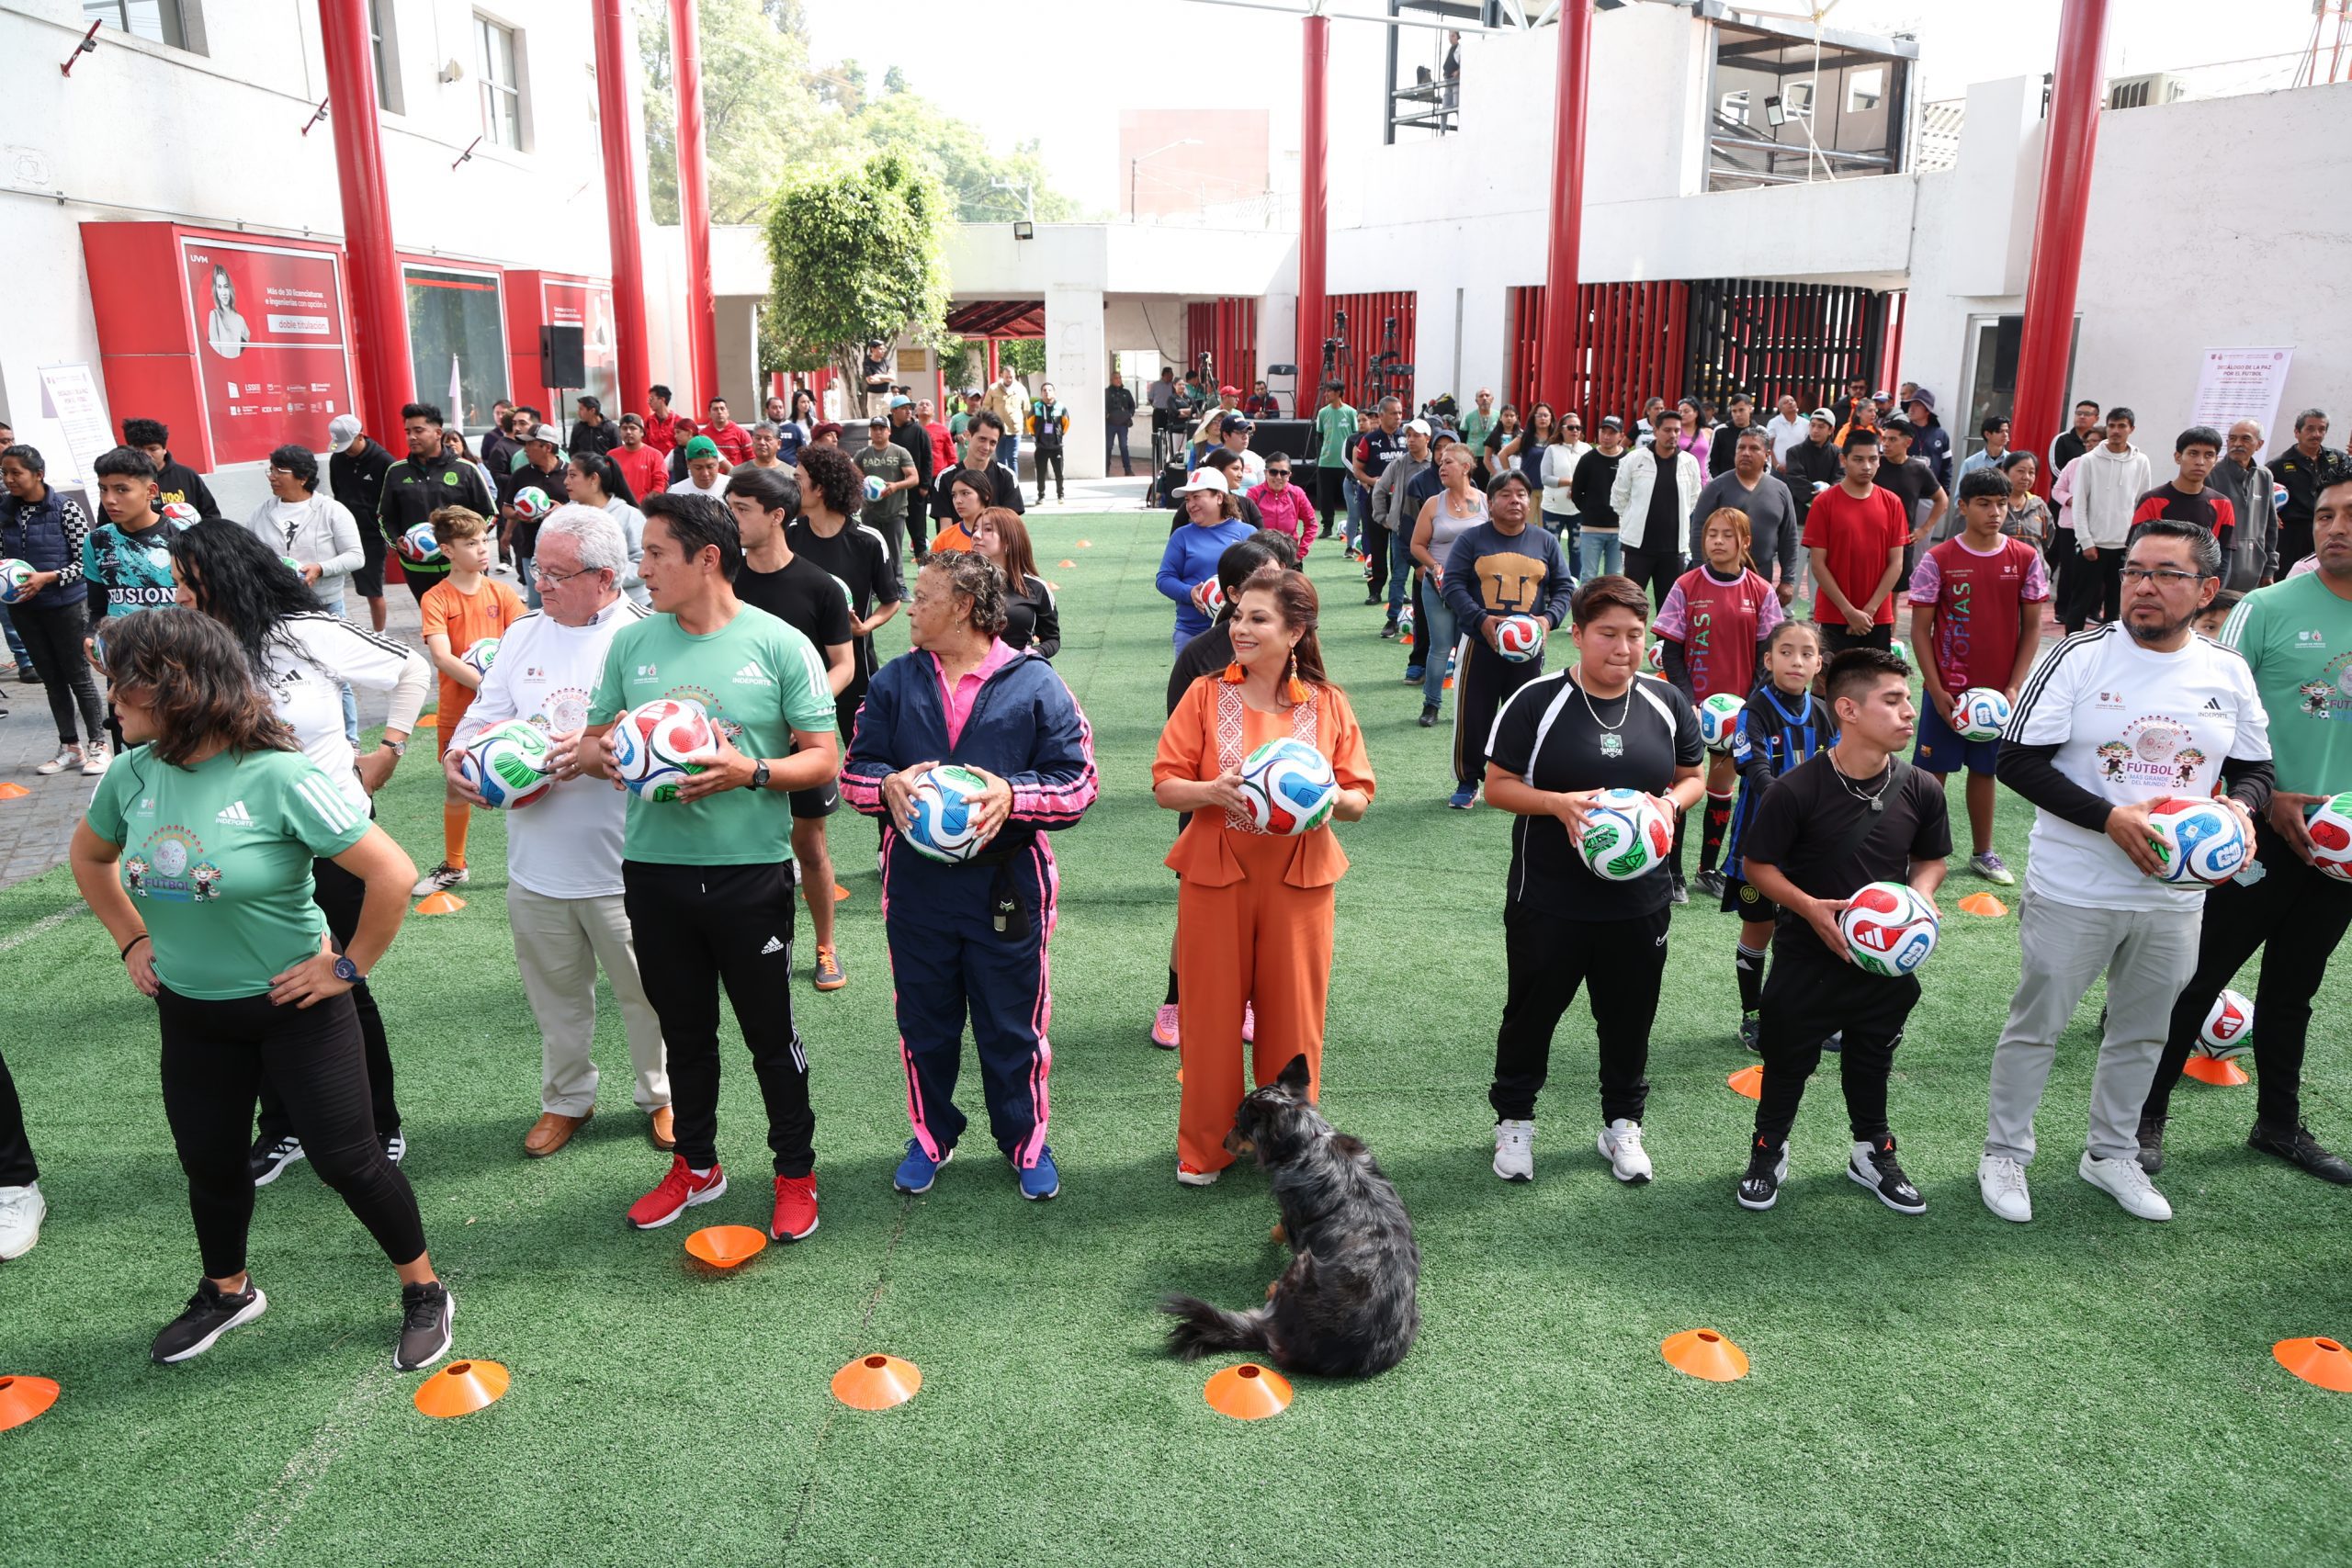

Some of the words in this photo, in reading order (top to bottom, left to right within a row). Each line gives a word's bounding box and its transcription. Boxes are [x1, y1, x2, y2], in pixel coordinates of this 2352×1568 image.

[190, 254, 209, 264] UVM
[279, 321, 297, 329] doble
[1380, 450, 1404, 460] BMW
[275, 680, 311, 690] NDEPORTE
[732, 677, 771, 686] INDEPORTE
[2126, 761, 2175, 776] FÚTBOL
[215, 817, 254, 828] INDEPORTE
[761, 942, 784, 955] adidas
